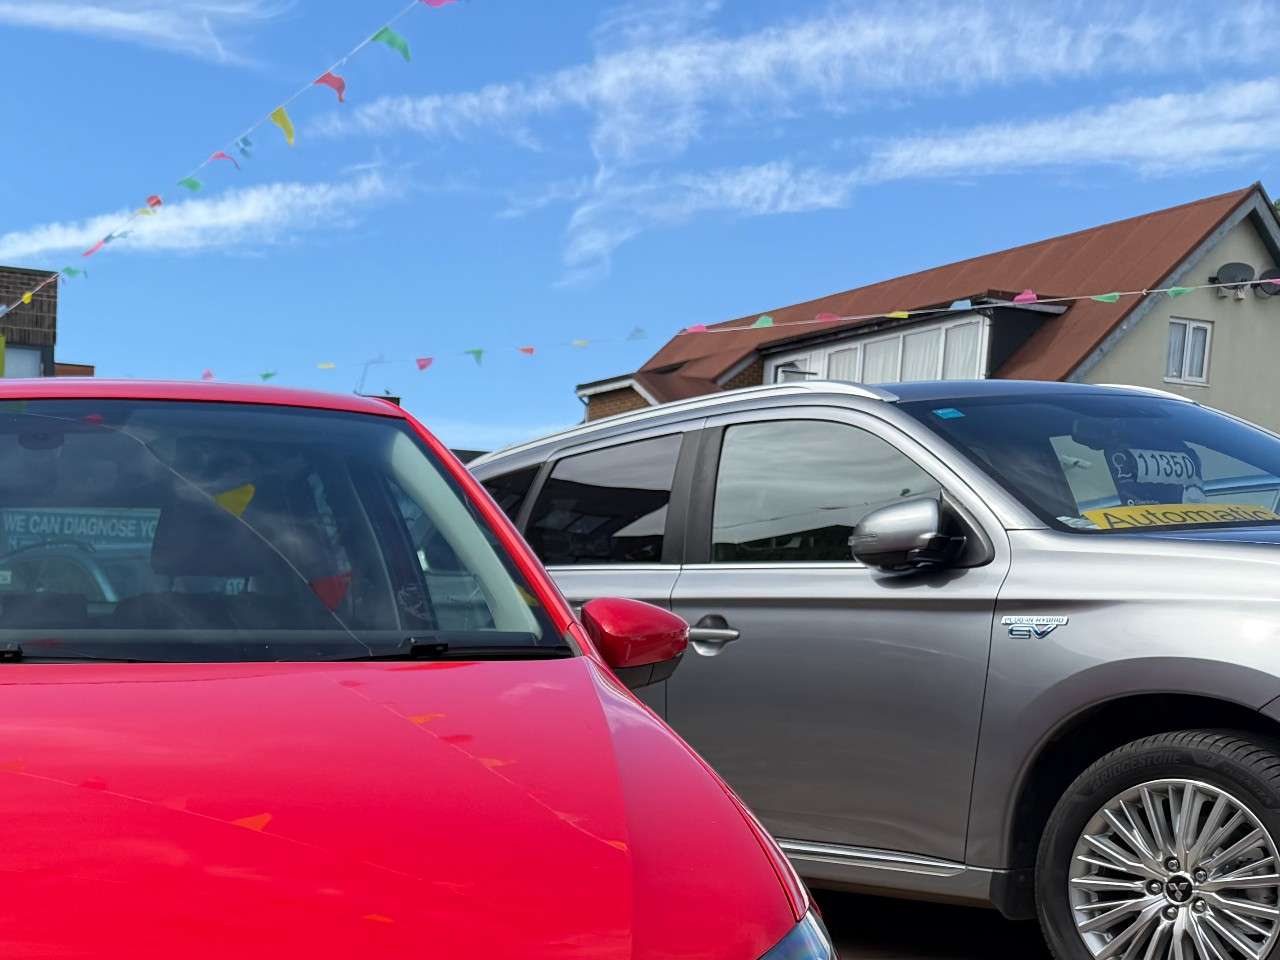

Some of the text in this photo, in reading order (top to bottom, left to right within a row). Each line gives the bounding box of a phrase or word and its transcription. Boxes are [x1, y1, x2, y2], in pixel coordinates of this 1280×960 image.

[4, 515, 25, 533] WE
[29, 515, 64, 534] CAN
[65, 515, 136, 537] DIAGNOSE
[1103, 506, 1268, 529] Automatic
